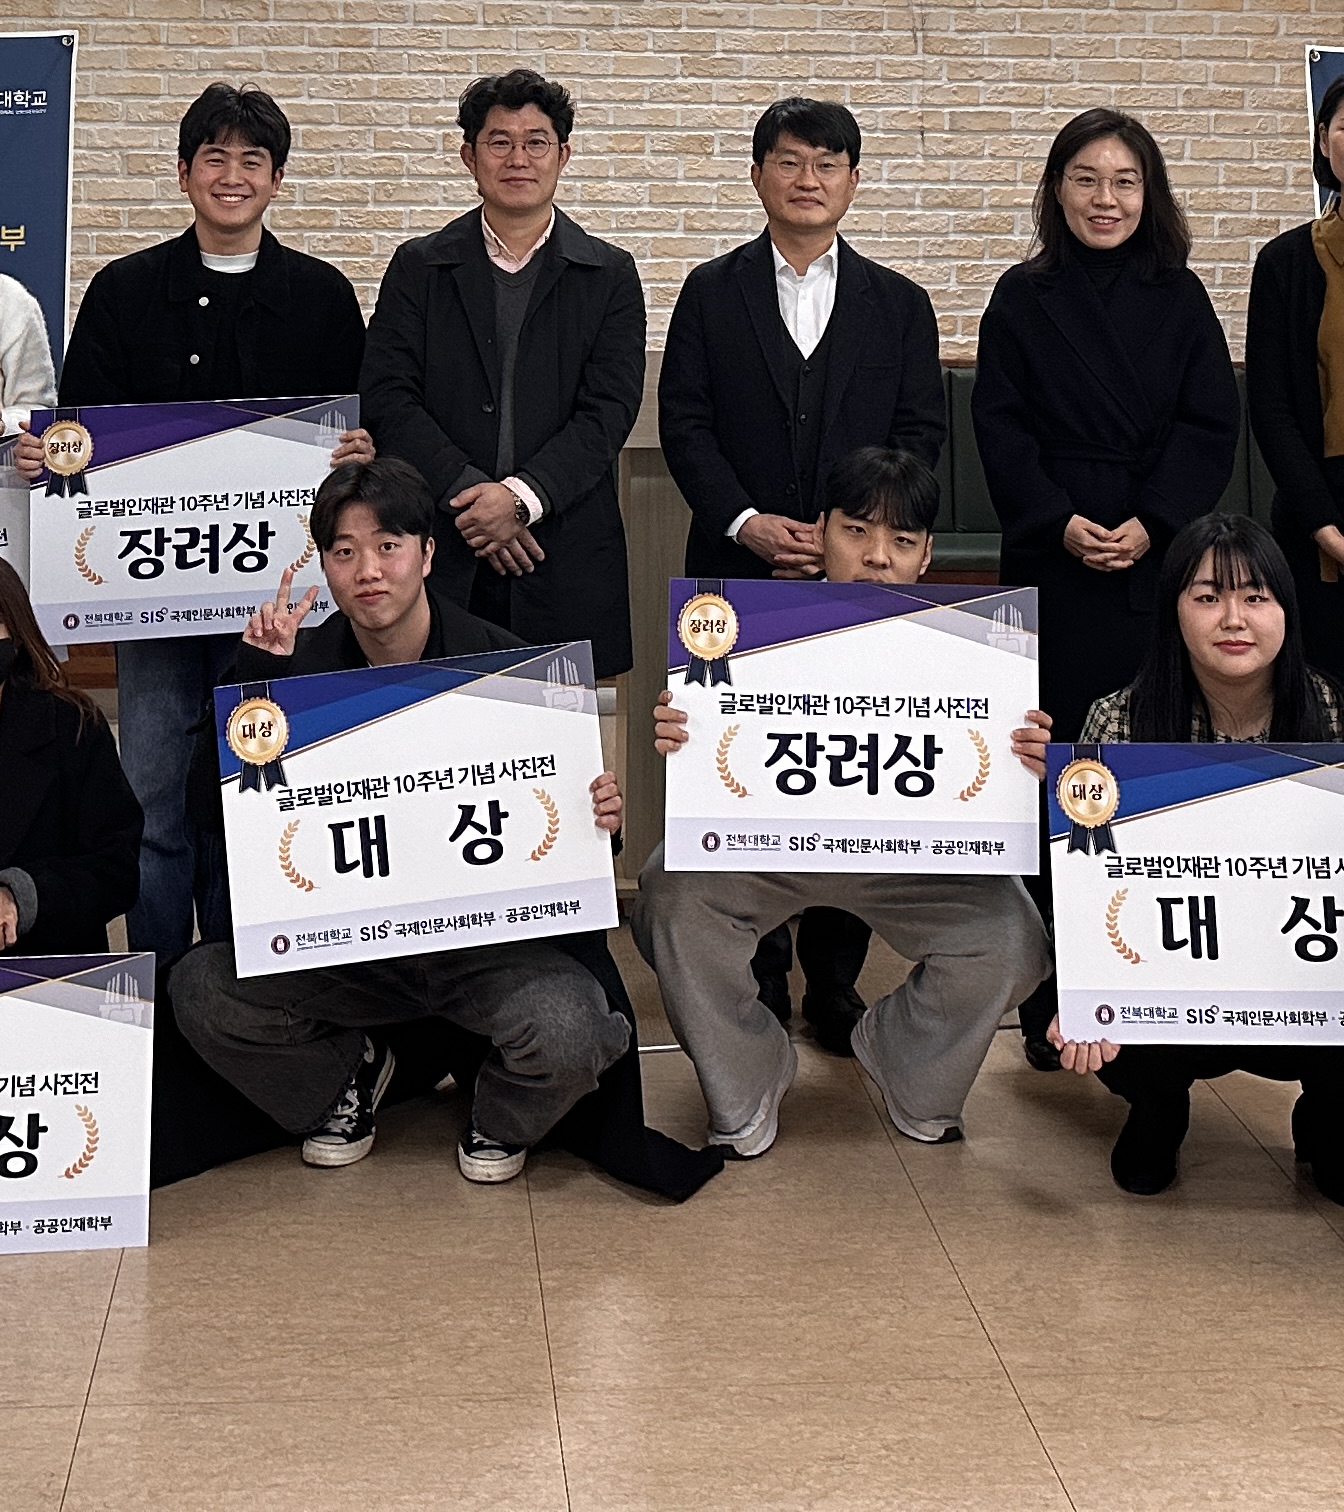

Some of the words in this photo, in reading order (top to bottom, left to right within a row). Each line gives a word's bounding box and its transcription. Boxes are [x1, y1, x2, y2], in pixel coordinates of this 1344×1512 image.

[49, 441, 83, 454] 장려상
[76, 499, 176, 520] 글로벌인재관
[179, 493, 230, 514] 10주년
[233, 491, 265, 510] 기념
[268, 488, 317, 508] 사진전
[118, 521, 276, 580] 장려상
[84, 611, 133, 624] 전북대학교
[690, 618, 727, 634] 장려상
[719, 693, 830, 716] 글로벌인재관
[834, 696, 890, 717] 10주년
[895, 697, 930, 718] 기념
[934, 697, 989, 719] 사진전
[765, 732, 943, 798] 장려상
[277, 781, 389, 812] 글로벌인재관
[393, 769, 455, 795] 10주년
[458, 762, 495, 787] 기념
[498, 754, 557, 780] 사진전
[725, 834, 781, 846] 전북대학교
[1105, 855, 1220, 879] 글로벌인재관
[1224, 857, 1287, 879] 10주년
[1292, 857, 1331, 880] 기념
[295, 928, 352, 945] 전북대학교
[1120, 1006, 1178, 1019] 전북대학교
[1222, 1010, 1328, 1027] 국제인문사회학부
[39, 1072, 99, 1095] 사진전
